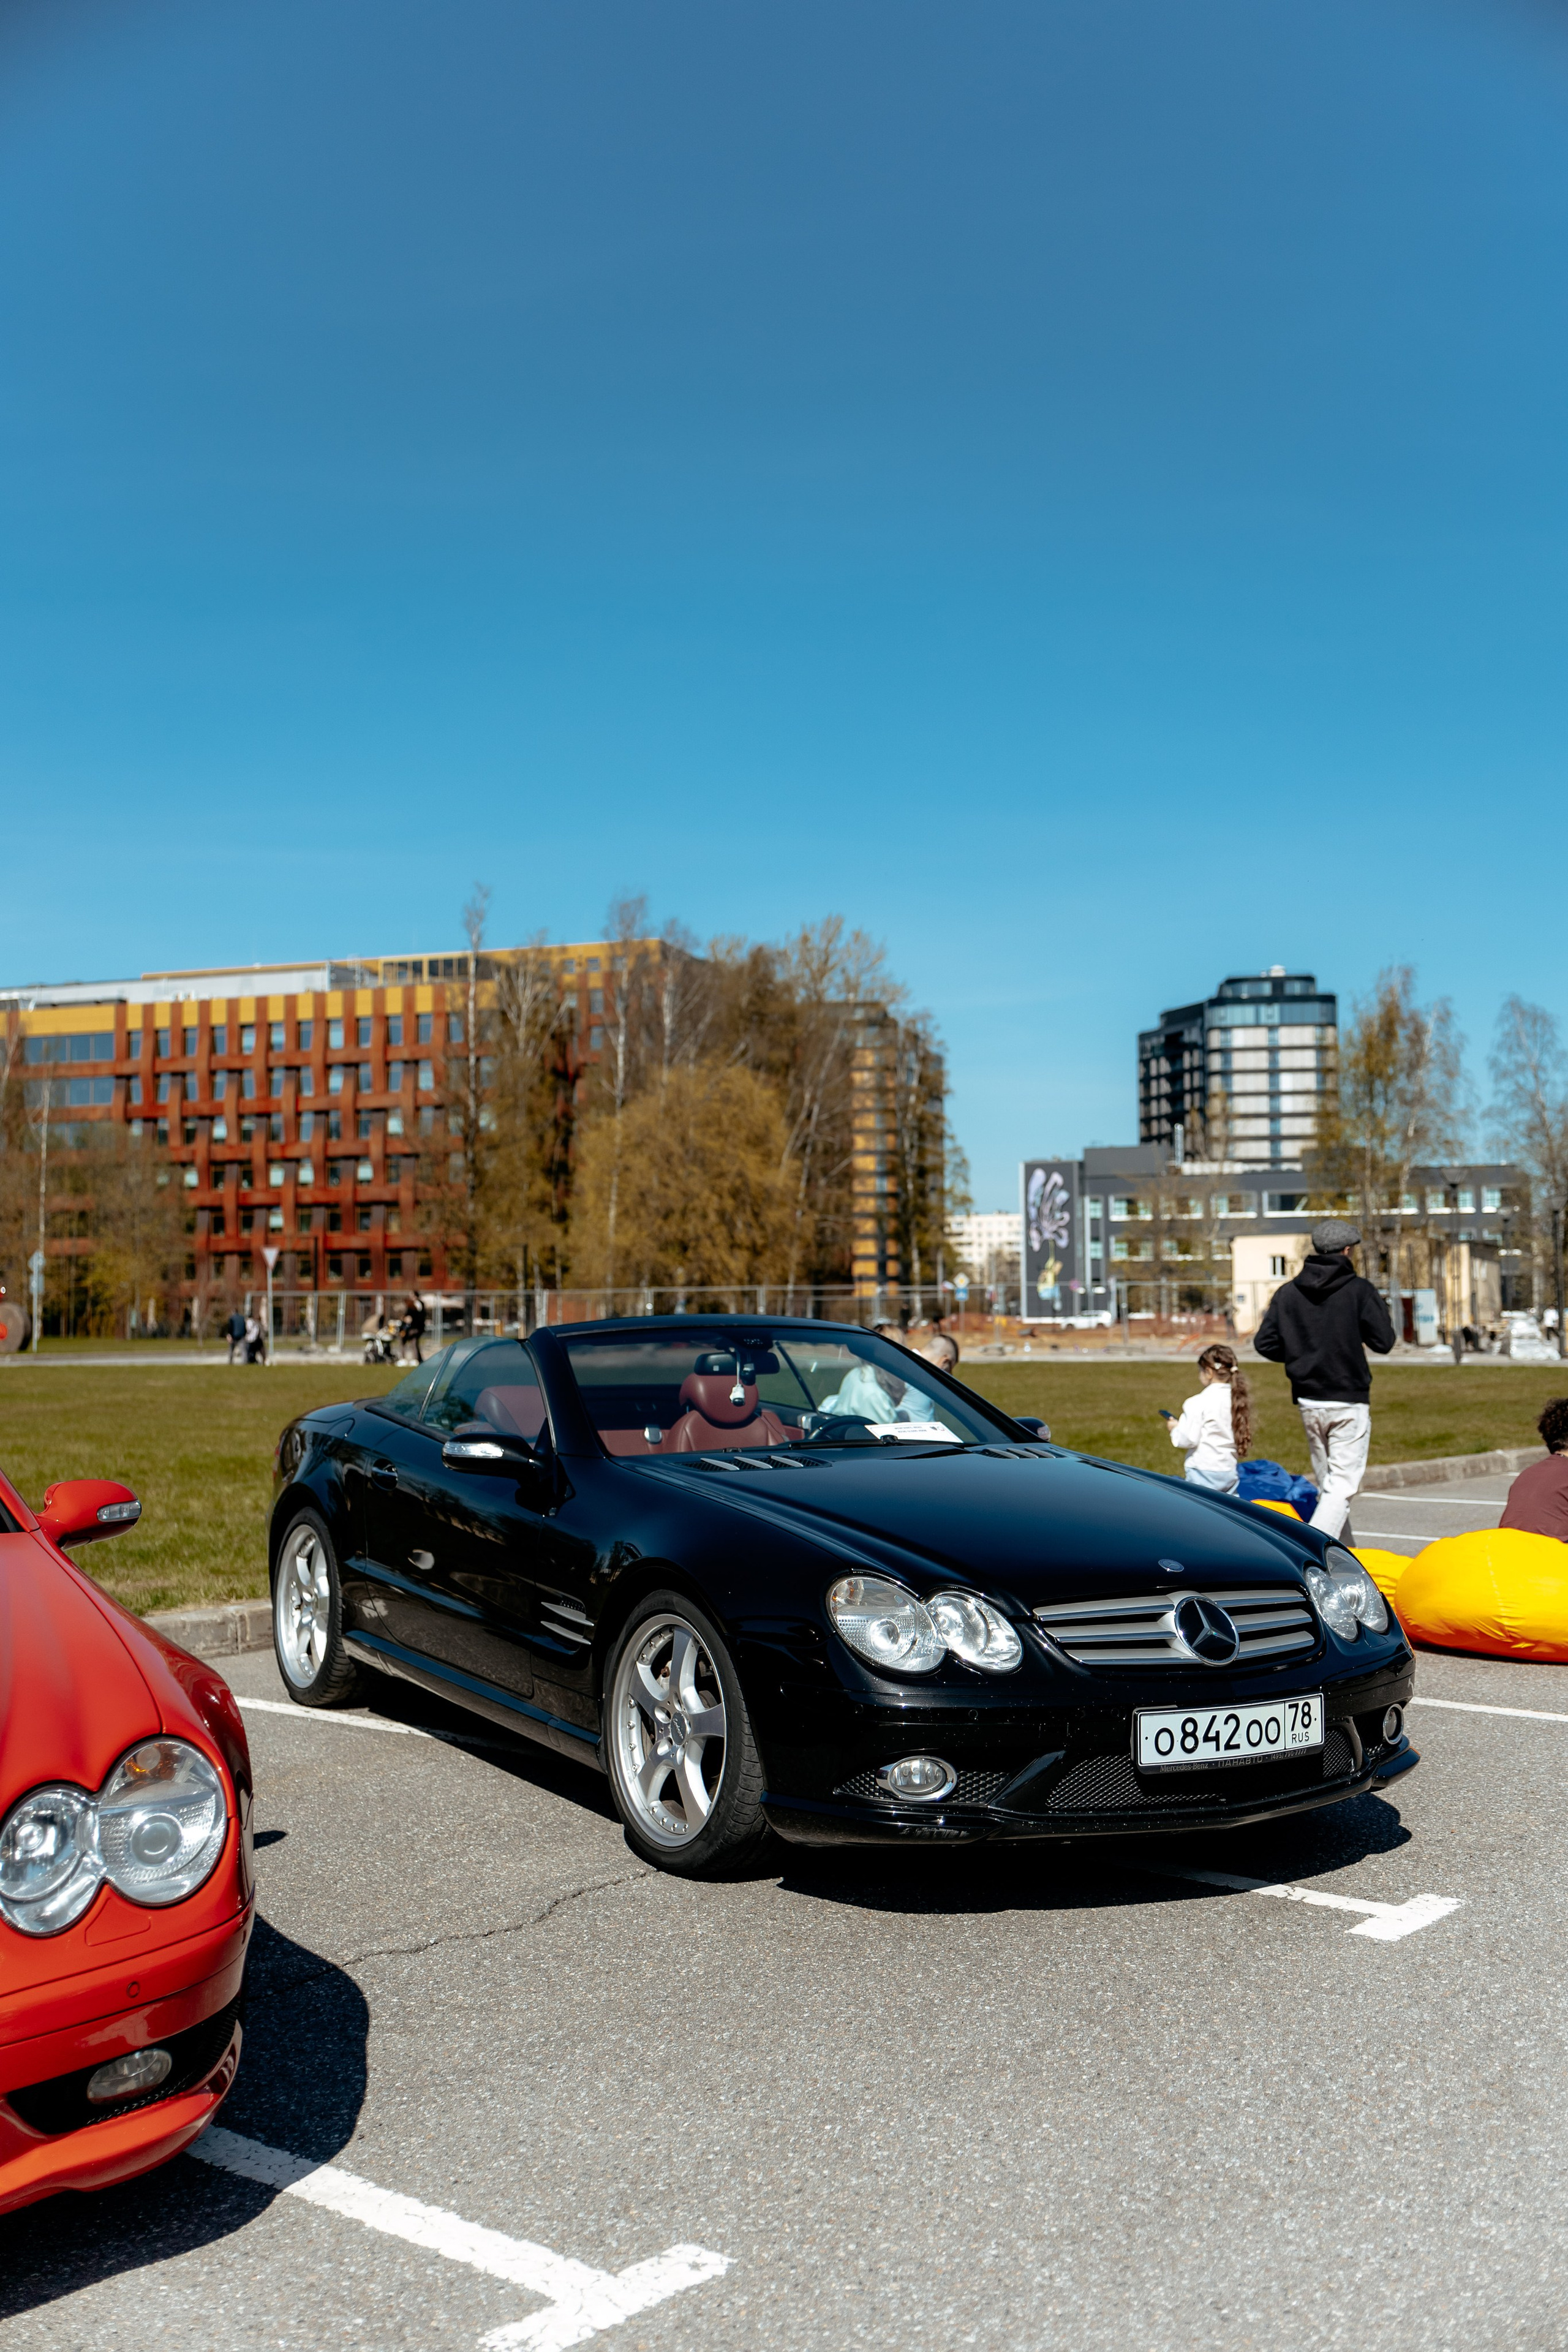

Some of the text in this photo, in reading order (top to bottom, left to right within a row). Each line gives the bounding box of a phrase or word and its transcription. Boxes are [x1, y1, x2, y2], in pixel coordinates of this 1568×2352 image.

[1287, 1701, 1313, 1732] 78
[1291, 1732, 1310, 1744] RUS
[1159, 1748, 1307, 1773] Mercedes-Benz ПАНАВТО (495) 790-7777
